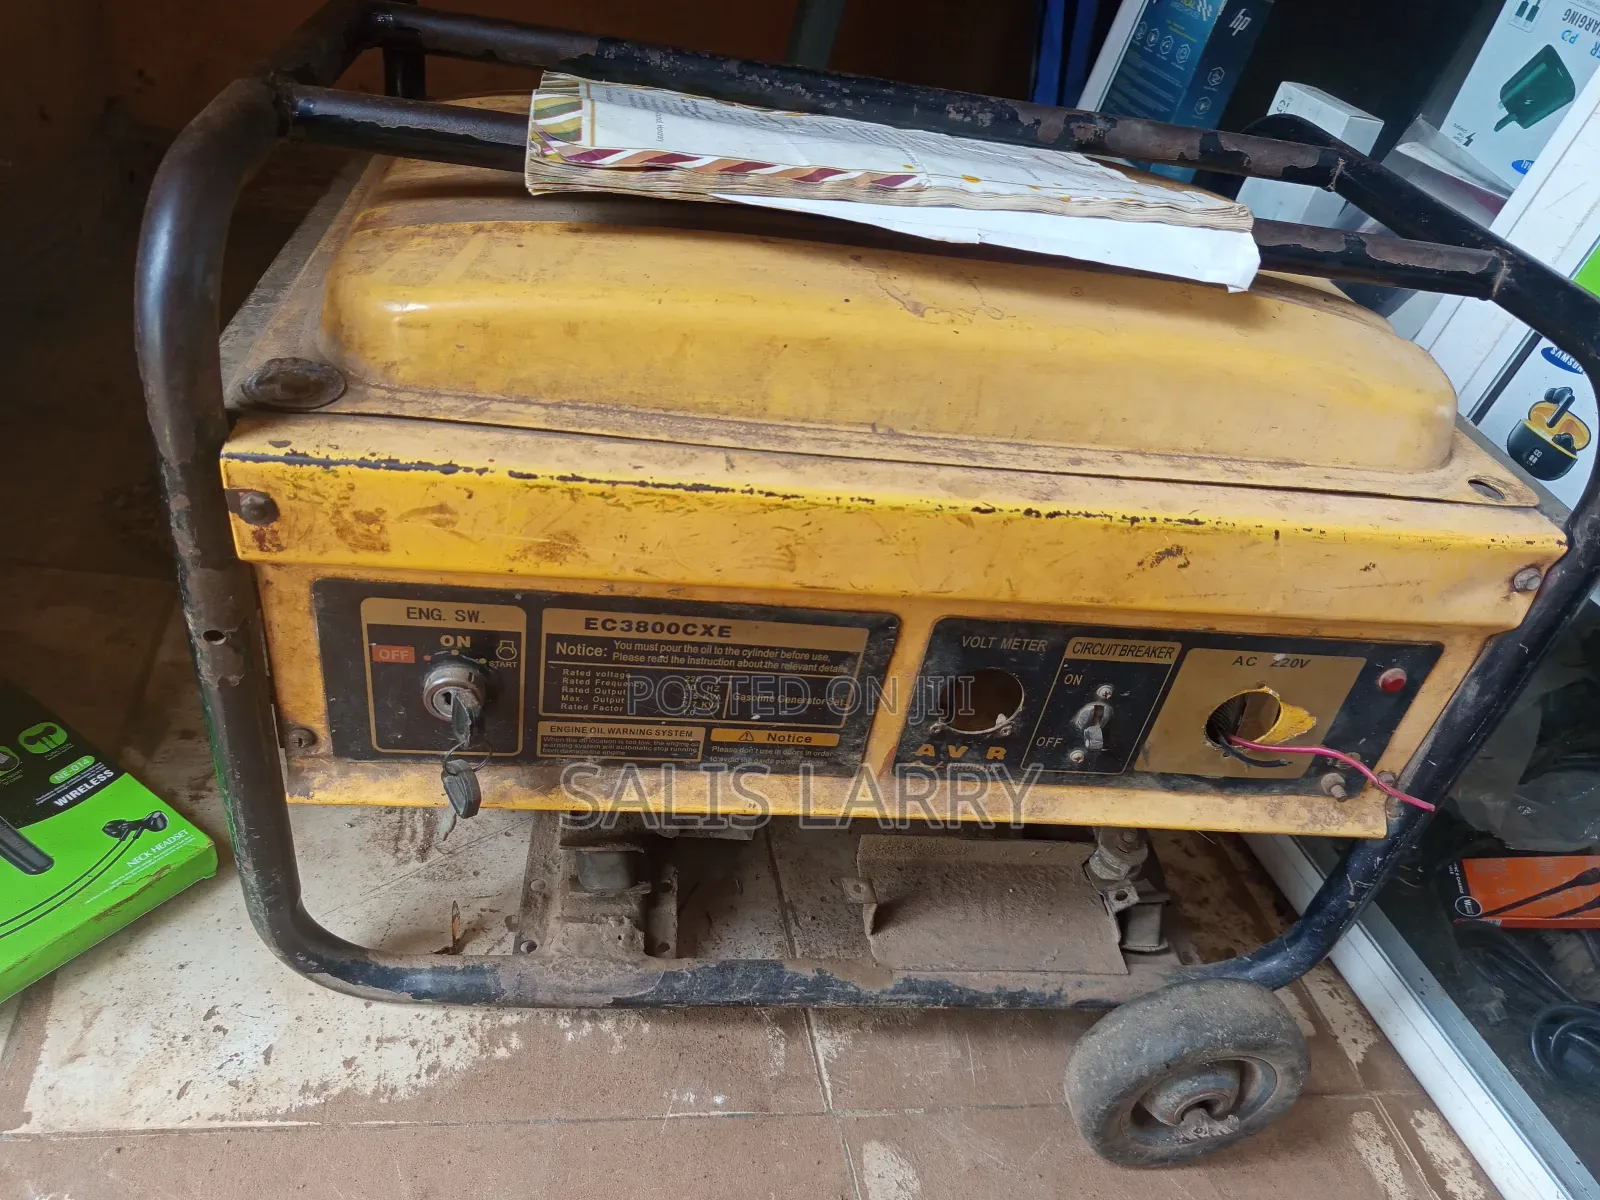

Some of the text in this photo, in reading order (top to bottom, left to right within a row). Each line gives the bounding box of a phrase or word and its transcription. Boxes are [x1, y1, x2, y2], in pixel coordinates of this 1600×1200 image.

[1228, 8, 1252, 36] hp
[405, 606, 486, 624] ENG. SW.
[584, 617, 732, 638] EC3800CXE
[439, 634, 471, 648] ON
[961, 635, 1048, 652] VOLT METER
[379, 649, 410, 661] OFF
[556, 641, 608, 657] Notice:
[614, 640, 631, 650] You
[634, 642, 658, 652] must
[659, 644, 682, 654] pour
[684, 644, 699, 653] the
[700, 644, 713, 654] oil
[714, 646, 723, 655] to
[725, 646, 740, 656] the
[742, 647, 778, 659] cylinder
[780, 649, 810, 660] before
[612, 651, 645, 663] Please
[647, 653, 669, 664] read
[671, 655, 685, 664] the
[687, 656, 735, 667] instruction
[737, 659, 763, 669] about
[765, 660, 779, 669] the
[781, 661, 817, 672] relevant
[1232, 655, 1312, 669] AC 220V
[562, 668, 591, 677] Rated
[595, 670, 631, 680] voltage
[1064, 673, 1083, 686] ON
[562, 677, 591, 686] Rated
[595, 678, 646, 689] Frequency
[561, 686, 590, 695] Rated
[594, 687, 627, 696] Output
[561, 694, 584, 703] Max.
[592, 695, 626, 705] Output
[733, 692, 776, 703] Gasoline
[777, 694, 825, 706] Generator
[560, 703, 589, 711] Rated
[592, 703, 624, 713] Factor
[550, 725, 693, 738] ENGINE OIL WARNING SYSTEM
[766, 732, 813, 744] Notice
[1036, 736, 1064, 748] OFF
[53, 757, 91, 783] NE-014
[53, 768, 115, 807] WIRELESS
[126, 828, 189, 868] NECK HEADSET
